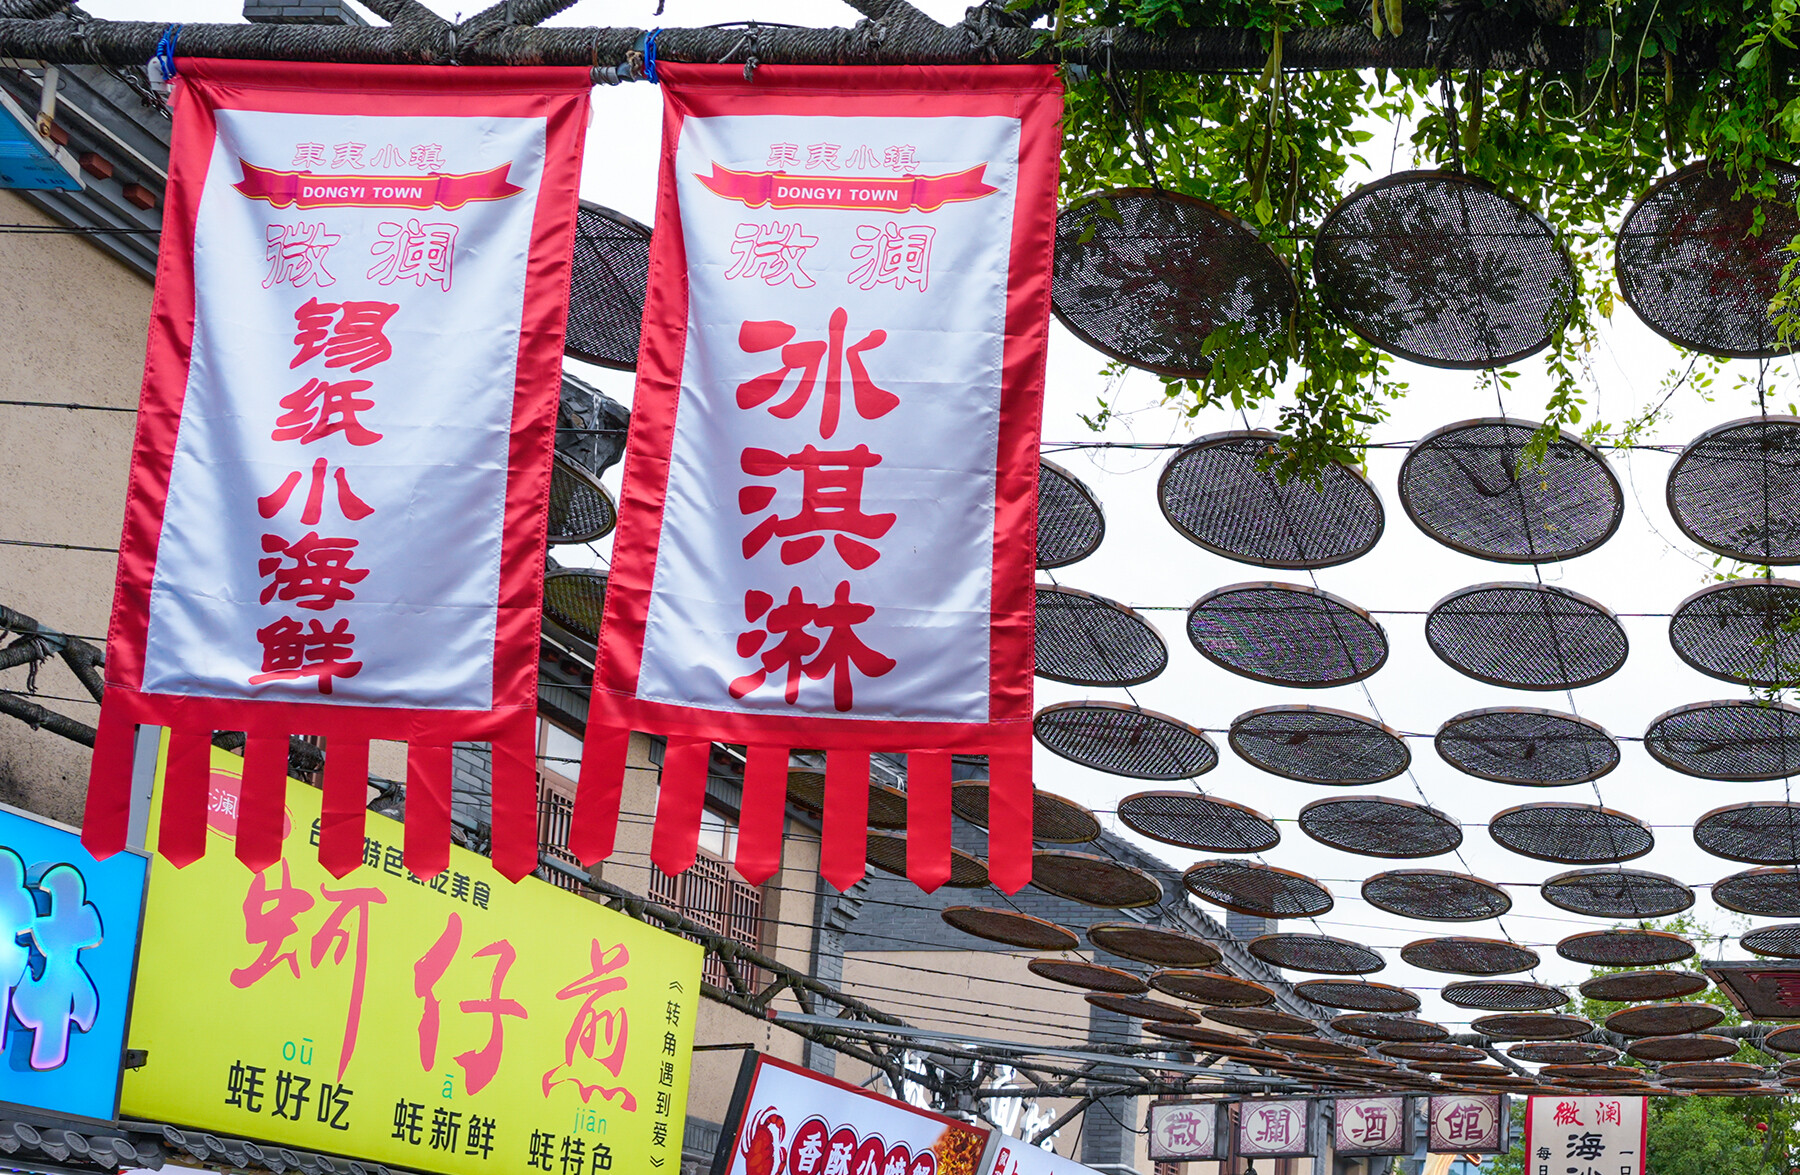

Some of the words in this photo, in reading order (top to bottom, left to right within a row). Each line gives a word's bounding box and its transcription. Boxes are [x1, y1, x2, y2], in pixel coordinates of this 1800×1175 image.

[302, 186, 365, 199] DONGYI
[373, 187, 423, 199] TOWN
[777, 186, 841, 201] DONGYI
[849, 189, 899, 202] TOWN
[249, 297, 400, 694] 锡纸小海鲜
[728, 306, 900, 713] 冰淇淋
[230, 857, 637, 1112] 蚵仔煎
[225, 1059, 354, 1131] 蚝好吃
[391, 1097, 497, 1160] 蚝新鲜
